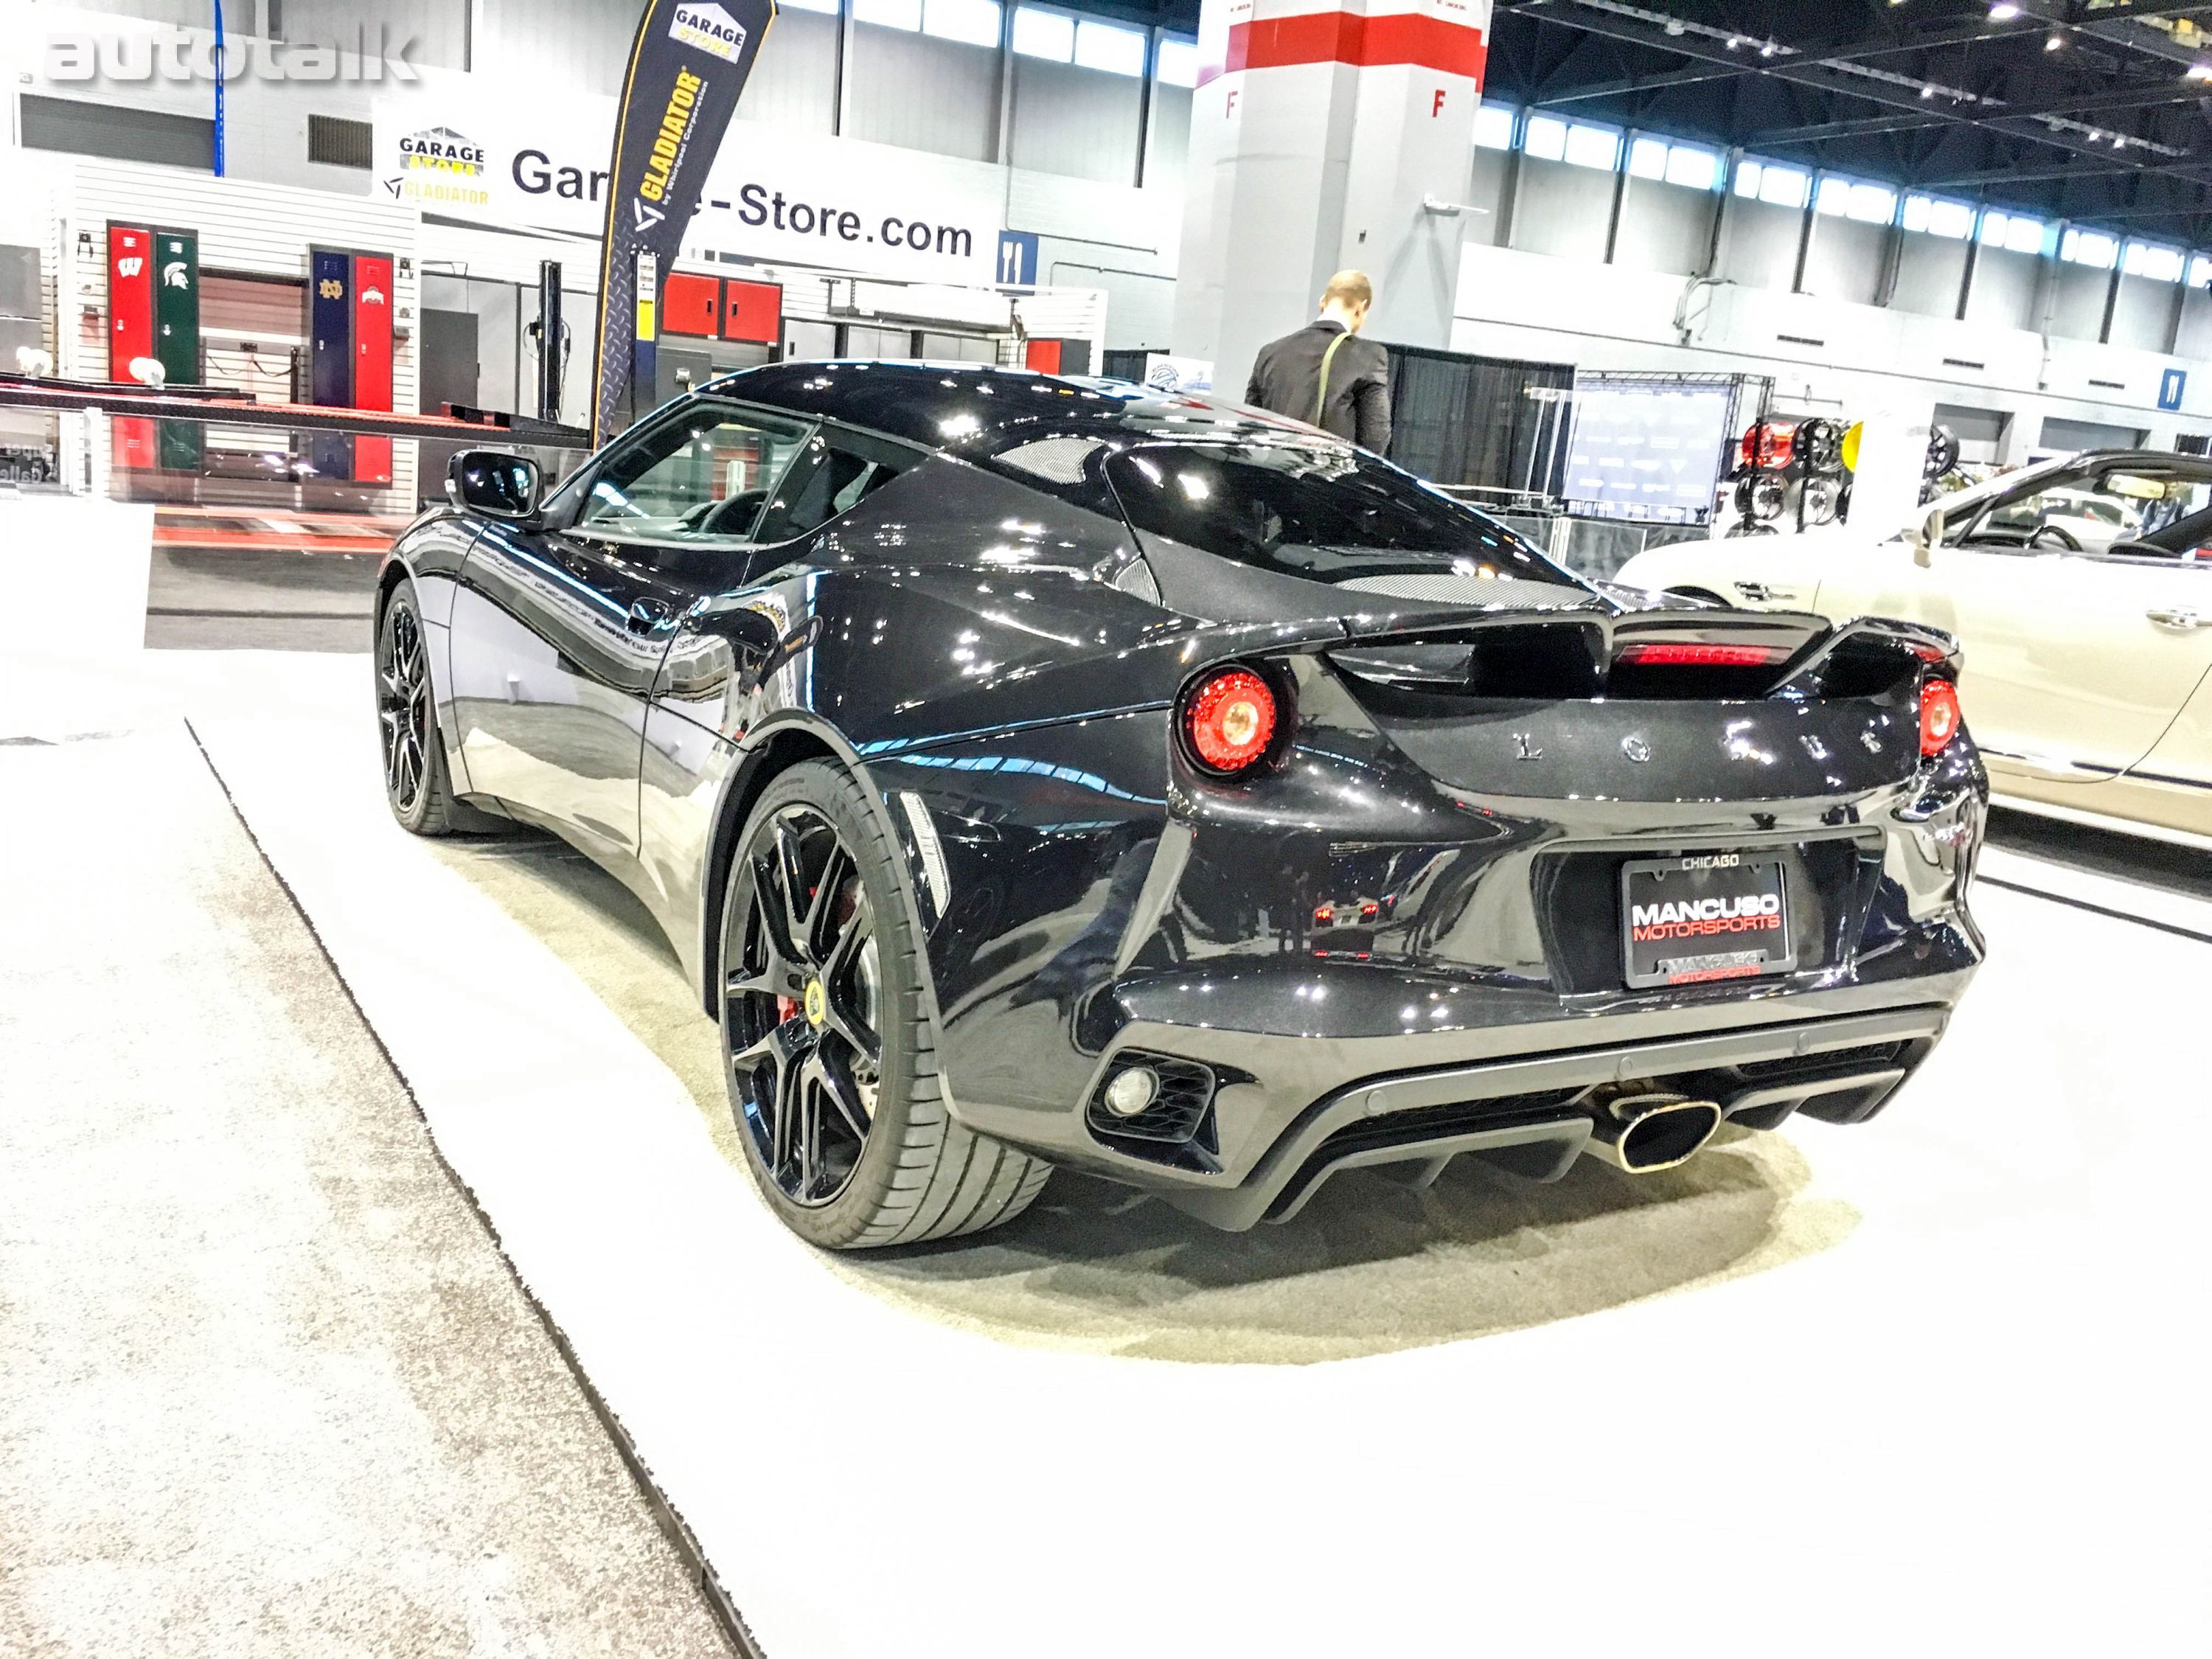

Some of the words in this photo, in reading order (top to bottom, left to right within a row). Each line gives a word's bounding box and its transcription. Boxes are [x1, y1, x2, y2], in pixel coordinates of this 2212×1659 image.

[676, 10, 743, 46] GARAGE
[678, 27, 731, 57] STORE
[1226, 91, 1239, 119] F
[1432, 89, 1446, 118] F
[400, 138, 484, 163] GARAGE
[639, 71, 701, 202] GLADIATOR
[661, 192, 672, 206] by
[667, 143, 687, 190] Whirlpool
[683, 80, 709, 142] Corporation
[404, 181, 489, 206] GLADIATOR
[1682, 854, 1740, 872] CHICAGO
[1632, 894, 1780, 927] MANCUSO
[1633, 914, 1781, 942] MOTORSPORTS
[1669, 964, 1761, 985] MOTORSPORTS
